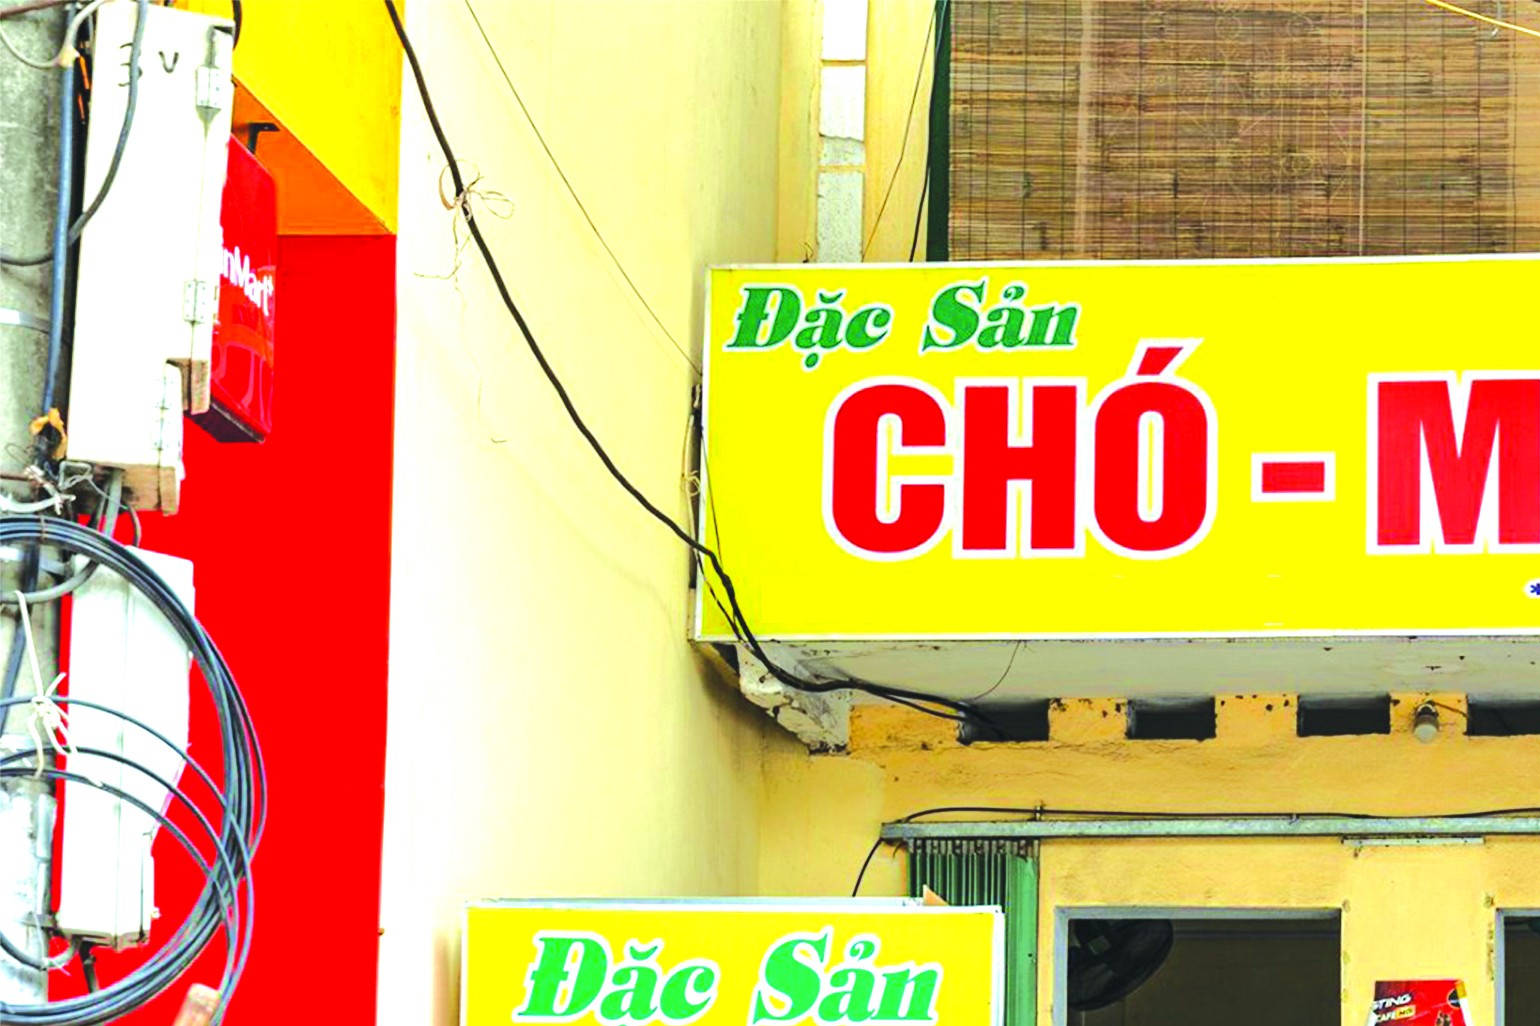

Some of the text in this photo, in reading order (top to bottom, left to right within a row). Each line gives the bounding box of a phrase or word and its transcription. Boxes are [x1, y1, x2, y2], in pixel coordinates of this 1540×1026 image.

[725, 280, 1079, 370] Đặc Sản
[831, 346, 1209, 553] CHÓ
[752, 932, 939, 1026] Sản
